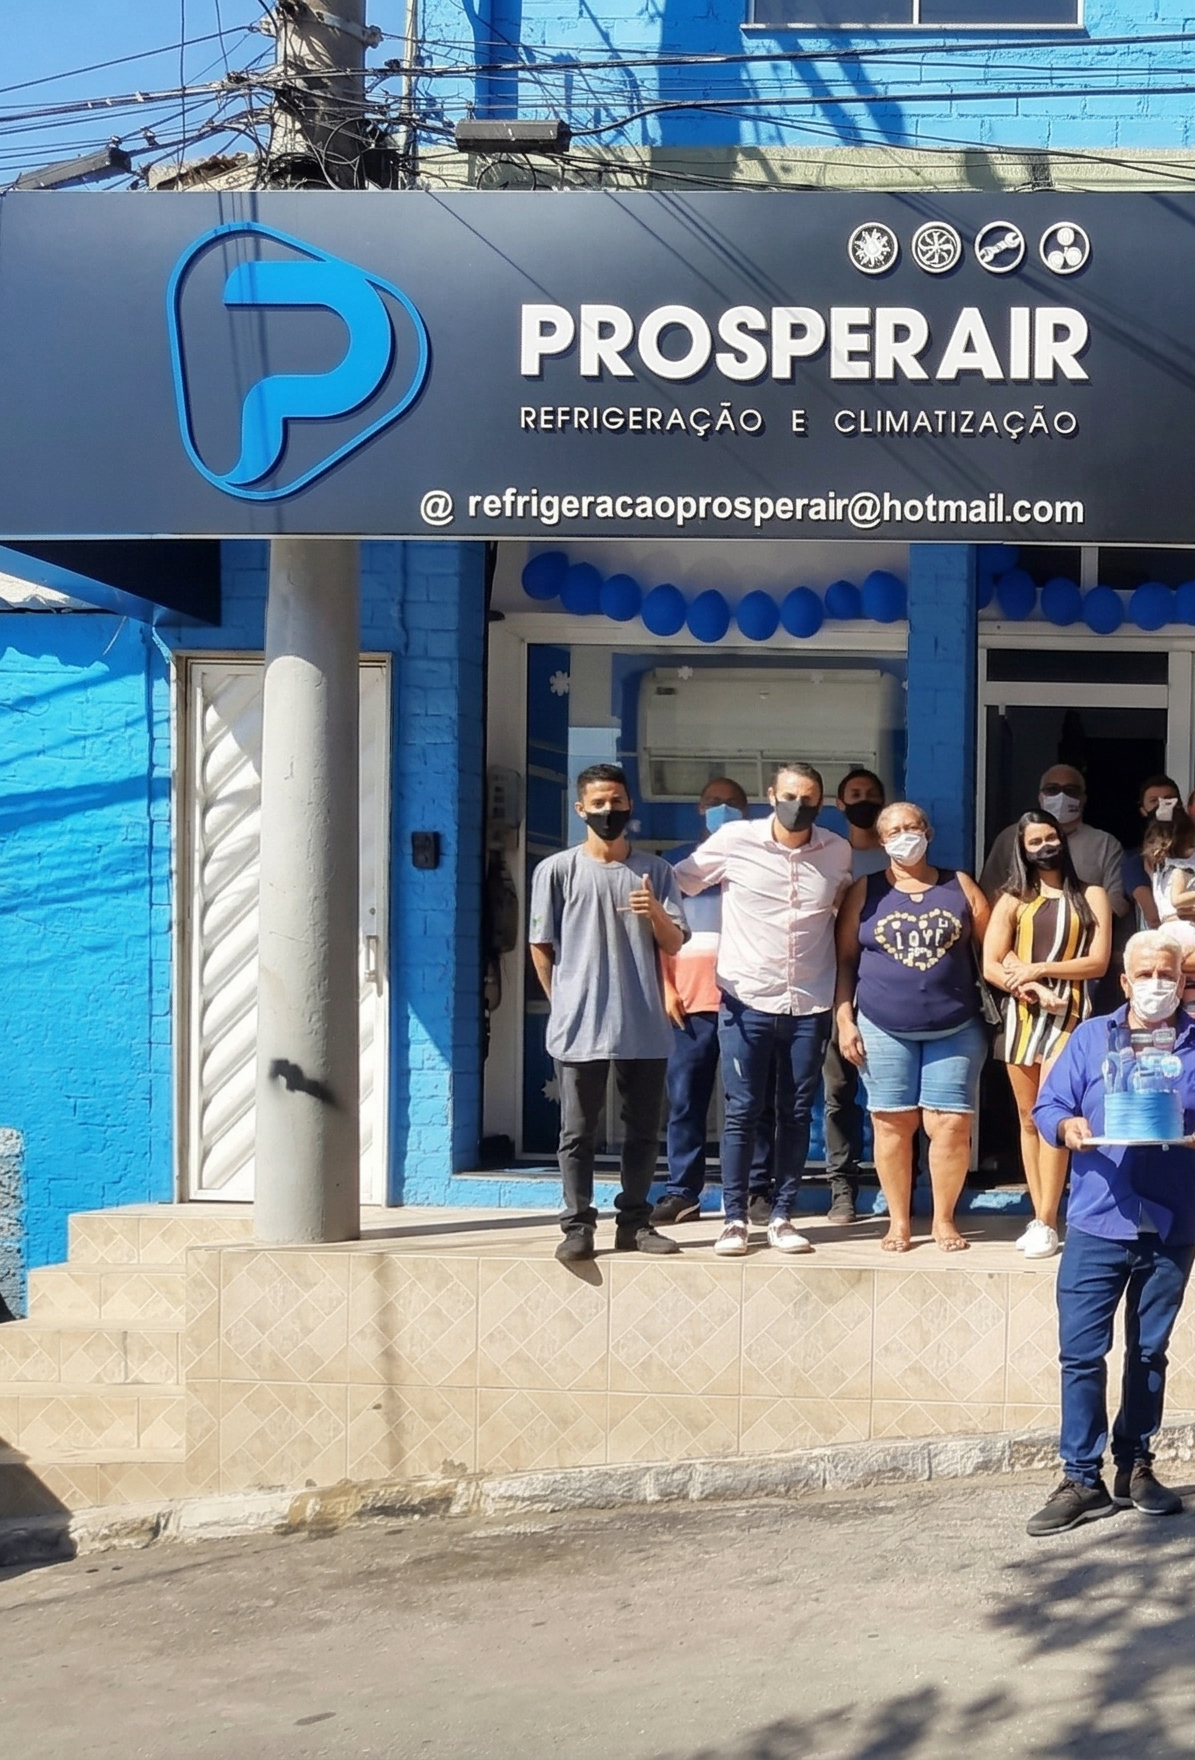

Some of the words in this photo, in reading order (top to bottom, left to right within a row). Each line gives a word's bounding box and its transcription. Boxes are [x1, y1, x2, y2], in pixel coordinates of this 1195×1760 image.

[520, 303, 1090, 381] PROSPERAIR
[520, 402, 762, 437] REFRIGERAÇÃO
[792, 409, 805, 432] E
[834, 405, 1078, 439] CLIMATIZAÇÃO
[468, 487, 1084, 529] refrigeracaoprosperair@hotmail.com
